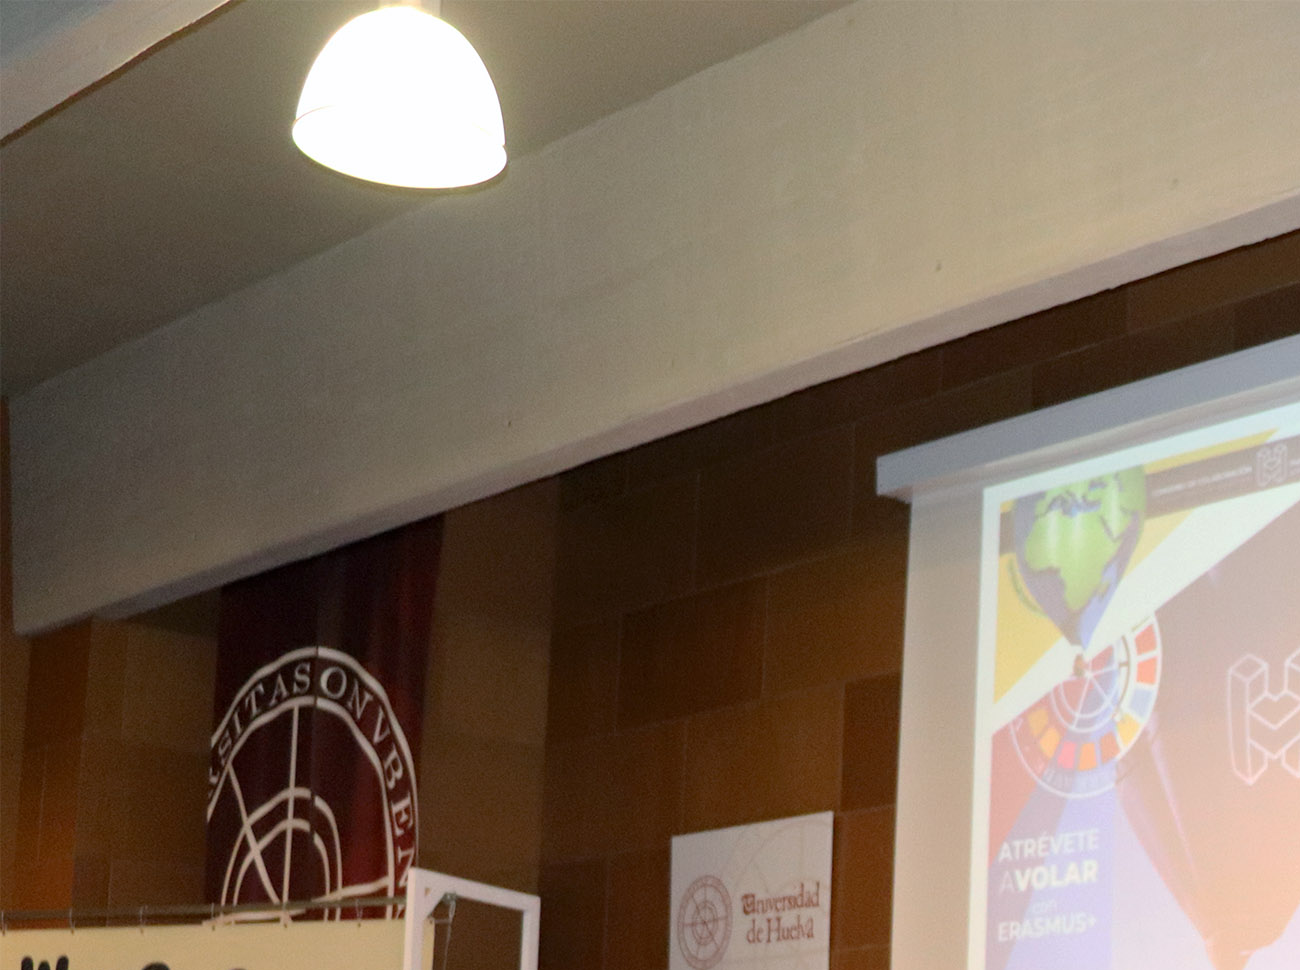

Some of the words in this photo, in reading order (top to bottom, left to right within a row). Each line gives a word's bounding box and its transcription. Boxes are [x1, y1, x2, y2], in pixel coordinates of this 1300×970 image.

[1014, 860, 1099, 893] VOLAR
[741, 881, 820, 916] Universidad
[746, 919, 763, 944] de
[765, 914, 814, 943] Huelva
